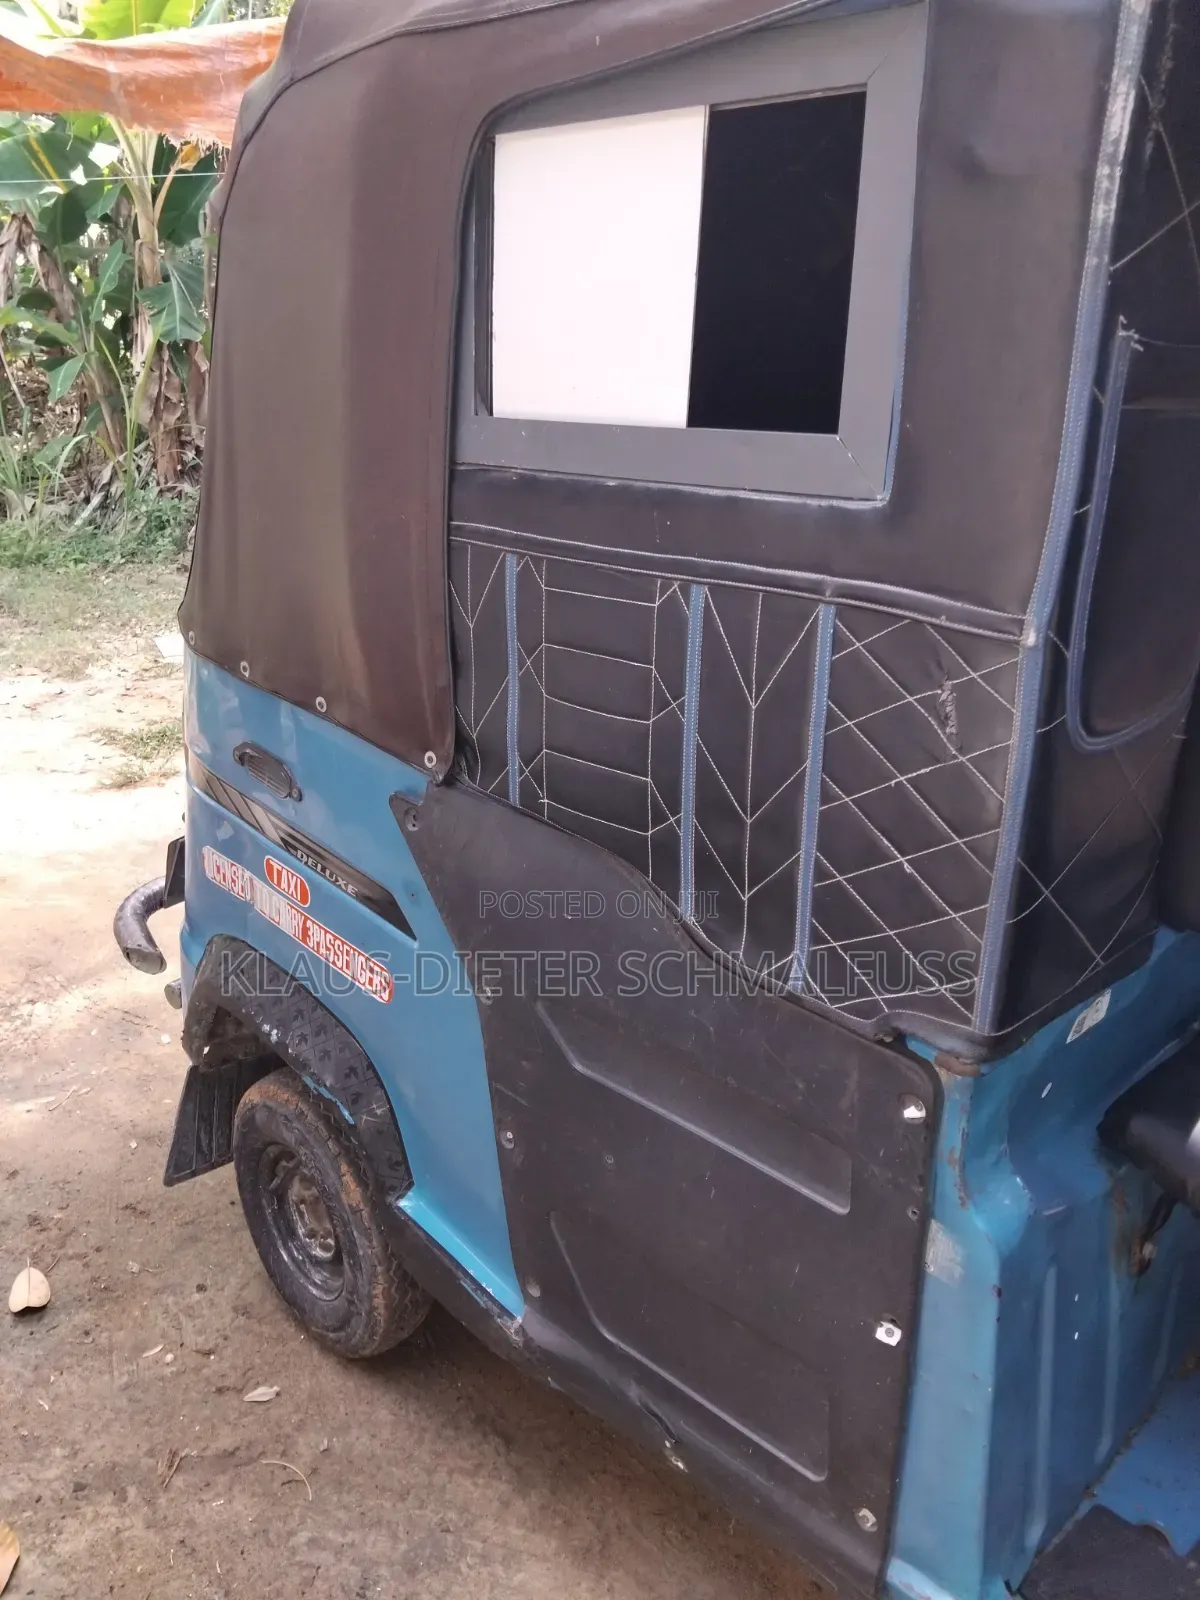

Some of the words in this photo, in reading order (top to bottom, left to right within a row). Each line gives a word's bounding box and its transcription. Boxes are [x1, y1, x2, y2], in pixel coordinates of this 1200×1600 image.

[204, 848, 251, 903] LICENSED
[269, 859, 301, 902] TAXI
[296, 849, 358, 897] DELUXE
